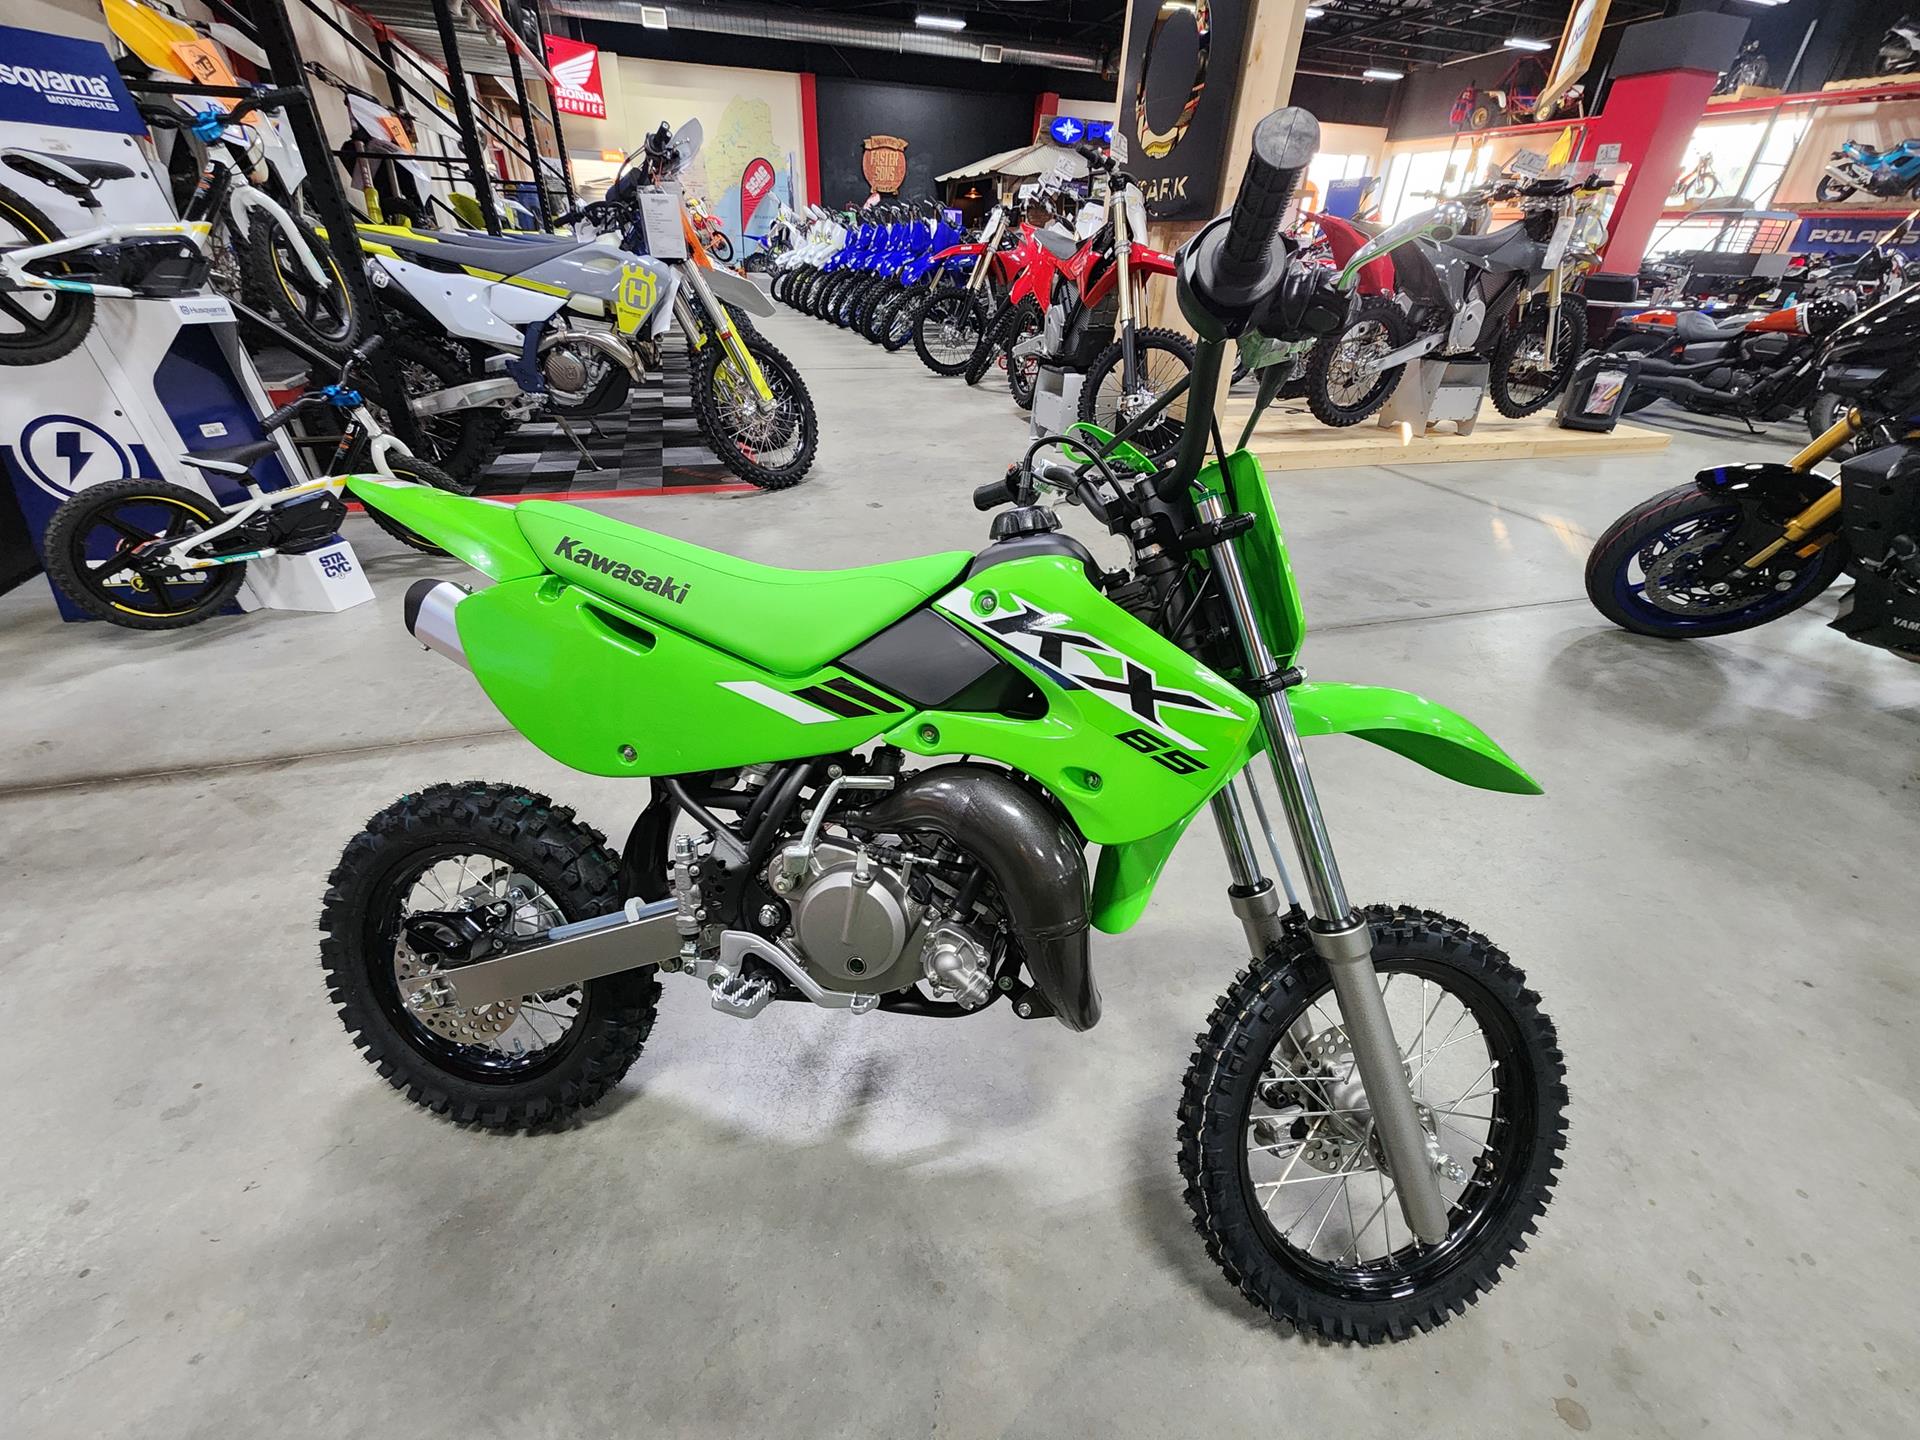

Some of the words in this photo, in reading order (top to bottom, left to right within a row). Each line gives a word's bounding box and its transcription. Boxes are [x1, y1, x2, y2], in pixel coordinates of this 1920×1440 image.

[45, 94, 120, 112] MOTORCYCLES
[556, 87, 603, 104] HONDA
[556, 97, 604, 115] SERVICE
[870, 150, 899, 167] FASTER
[875, 166, 896, 181] SONS
[553, 535, 692, 605] Kawasaki
[982, 600, 1222, 730] KX
[1113, 728, 1211, 775] 65
